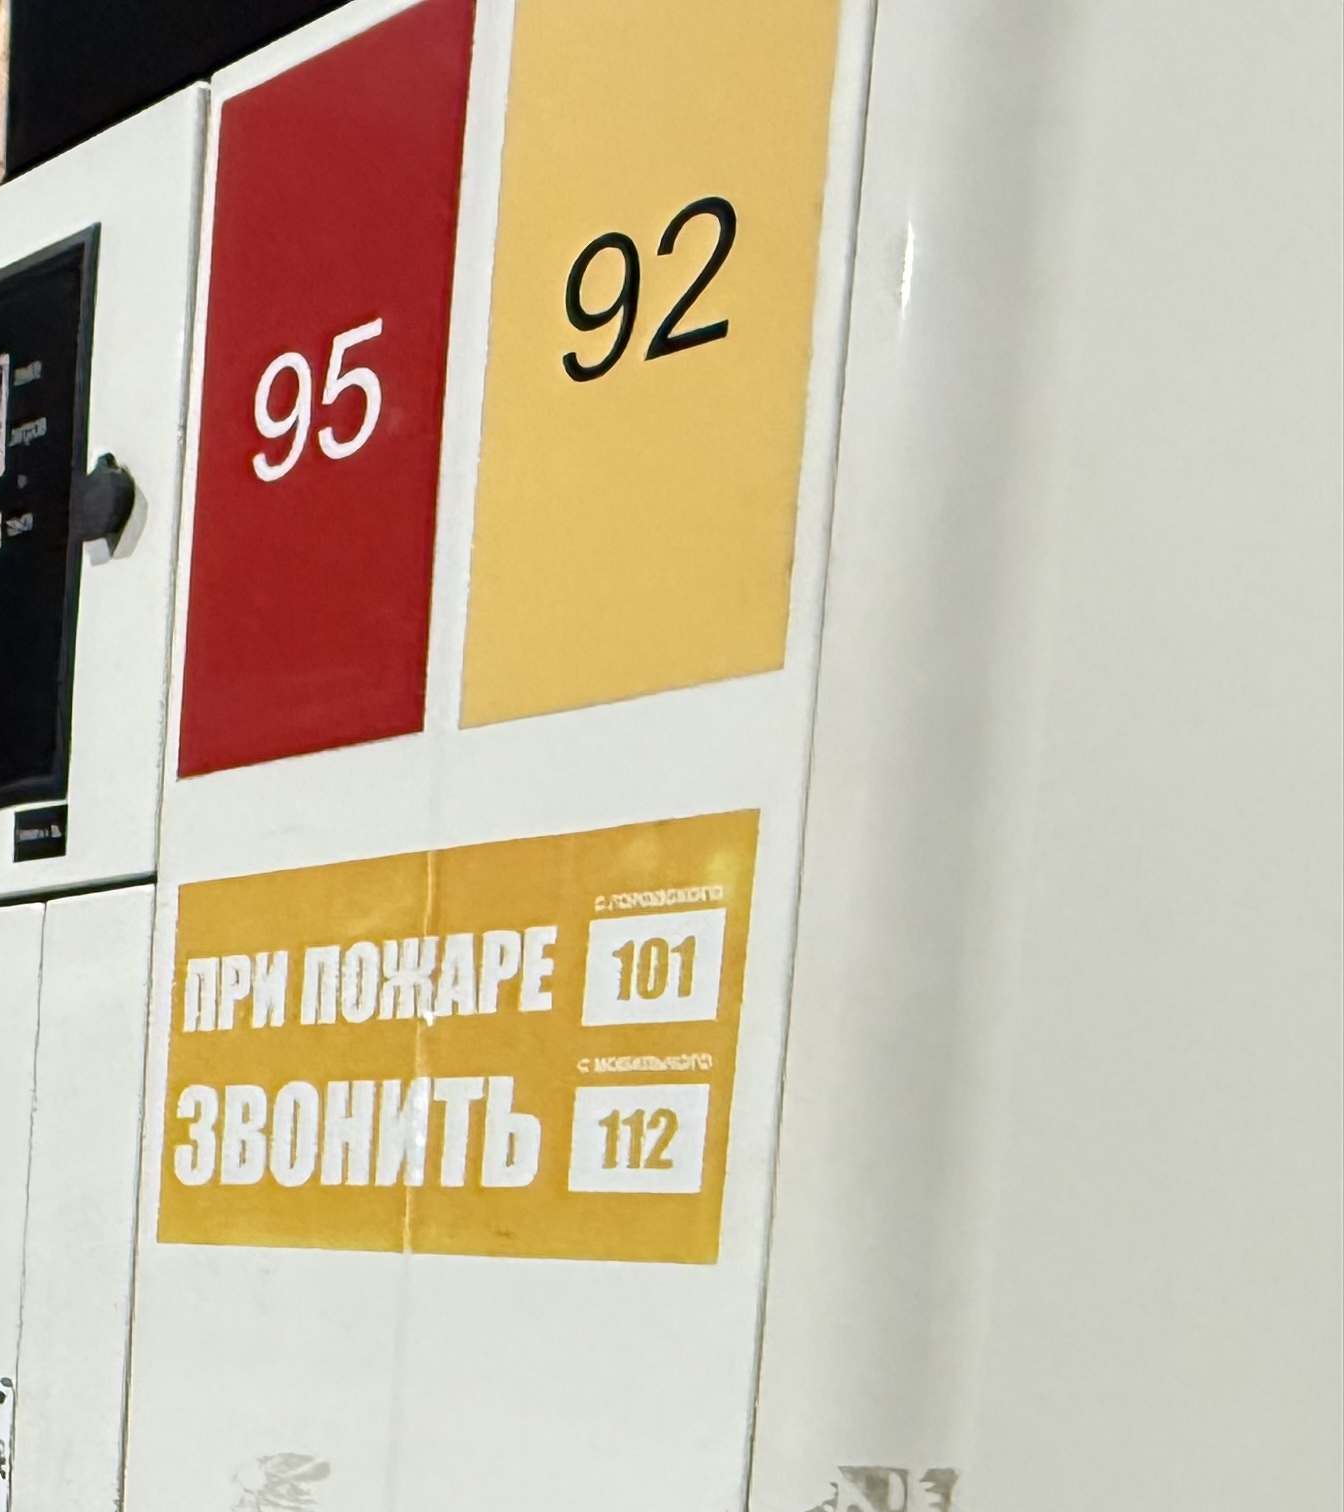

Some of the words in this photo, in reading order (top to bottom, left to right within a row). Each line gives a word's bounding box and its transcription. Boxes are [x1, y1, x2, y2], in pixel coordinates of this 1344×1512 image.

[562, 195, 737, 383] 92
[253, 317, 383, 483] 95
[182, 950, 288, 1033] ПРИ
[300, 926, 559, 1022] ПОЖАРЕ
[611, 935, 698, 1001] 101
[173, 1074, 542, 1189] ЗВОНИТЬ
[598, 1108, 680, 1170] 112
